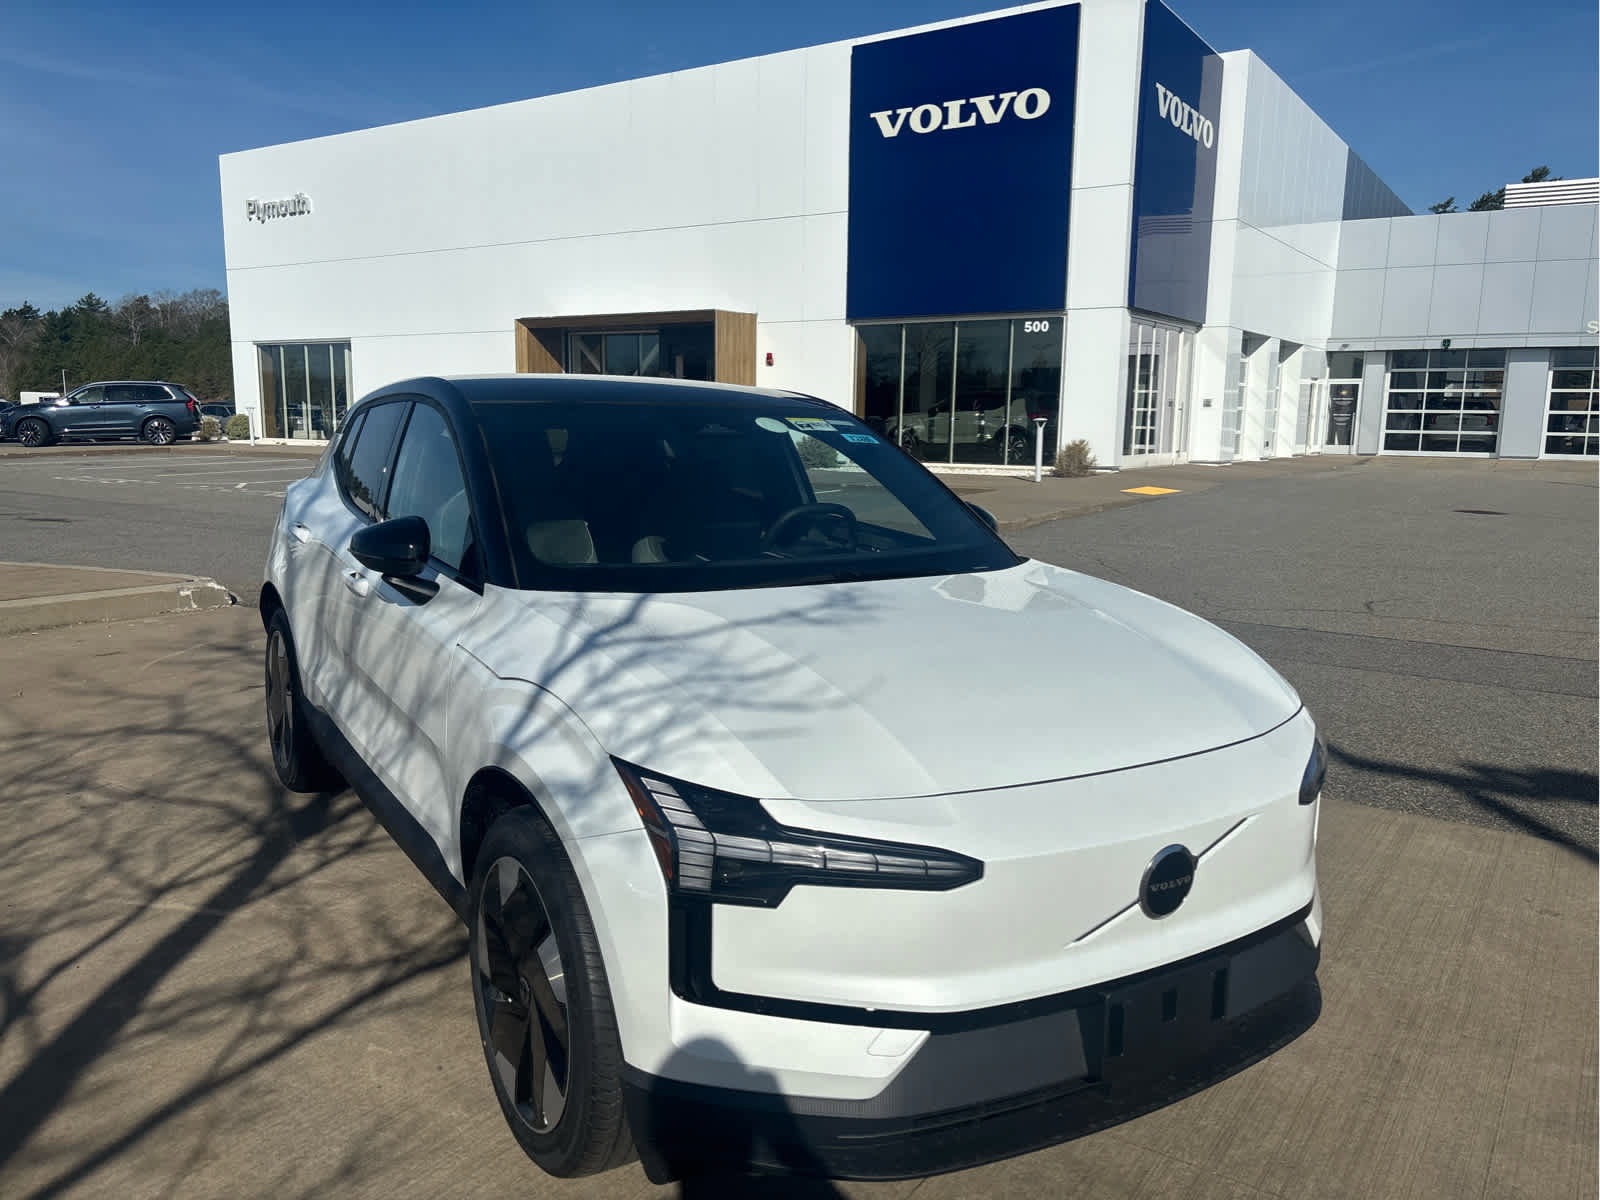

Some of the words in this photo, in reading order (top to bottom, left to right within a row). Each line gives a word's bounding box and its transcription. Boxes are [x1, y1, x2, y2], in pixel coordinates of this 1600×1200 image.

[870, 87, 1051, 138] VOLVO
[1156, 82, 1214, 149] VOLVO
[246, 192, 311, 224] Plymouth
[1024, 320, 1049, 333] 500
[1150, 875, 1192, 892] VOLVO
